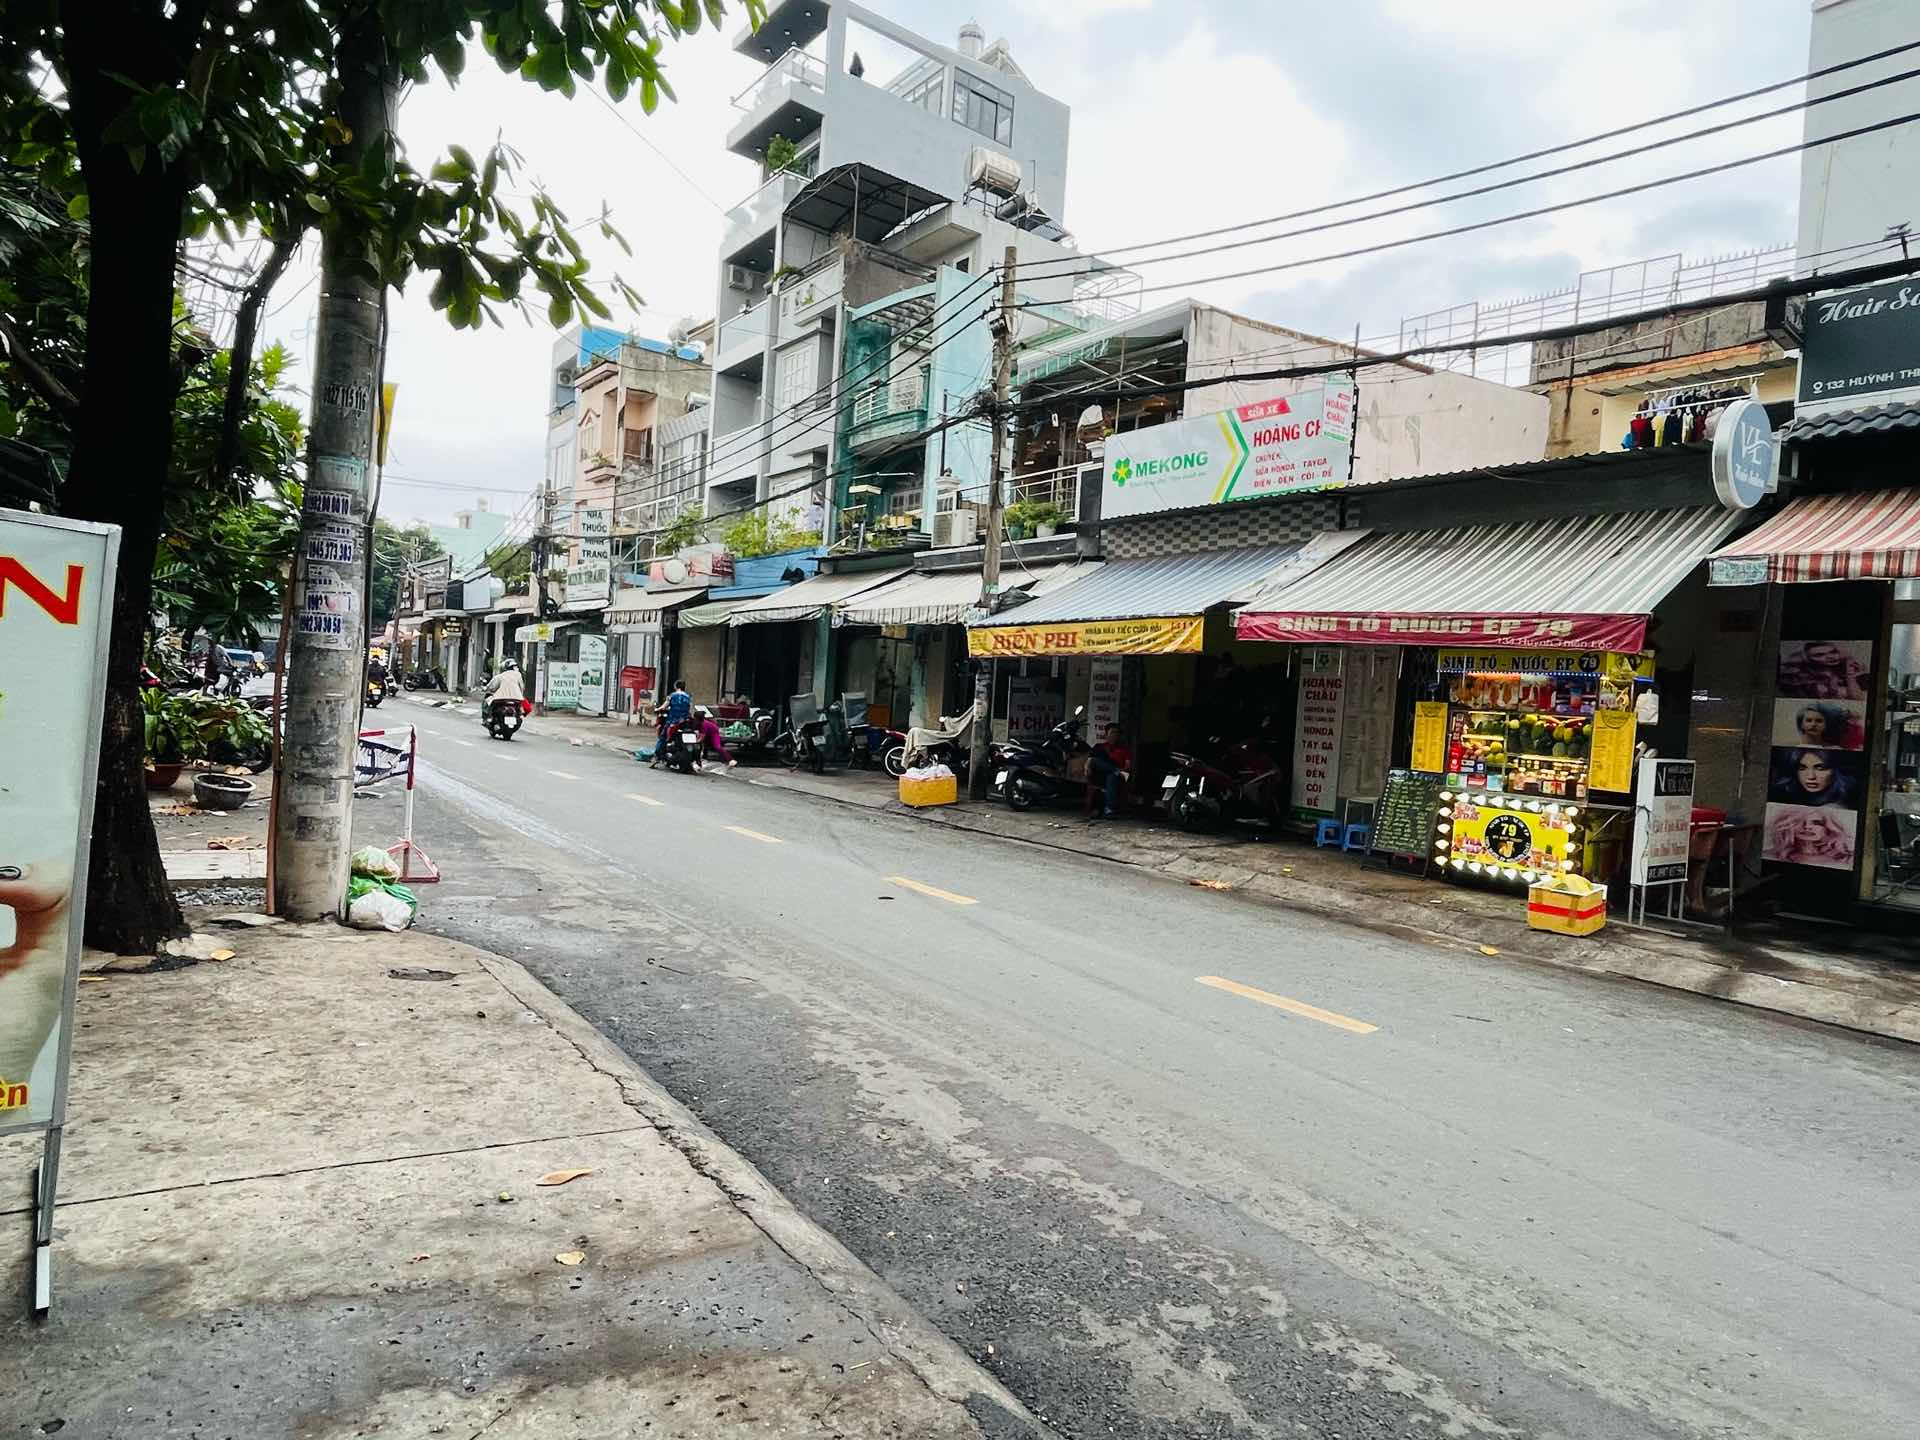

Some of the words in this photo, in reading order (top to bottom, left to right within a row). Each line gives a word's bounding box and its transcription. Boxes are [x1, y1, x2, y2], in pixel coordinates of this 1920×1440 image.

[1819, 299, 1887, 324] Hair
[1826, 380, 1846, 390] 132
[1136, 453, 1208, 478] MEKONG
[1278, 616, 1338, 632] SINH
[1581, 656, 1598, 670] 79
[1501, 823, 1517, 837] 79
